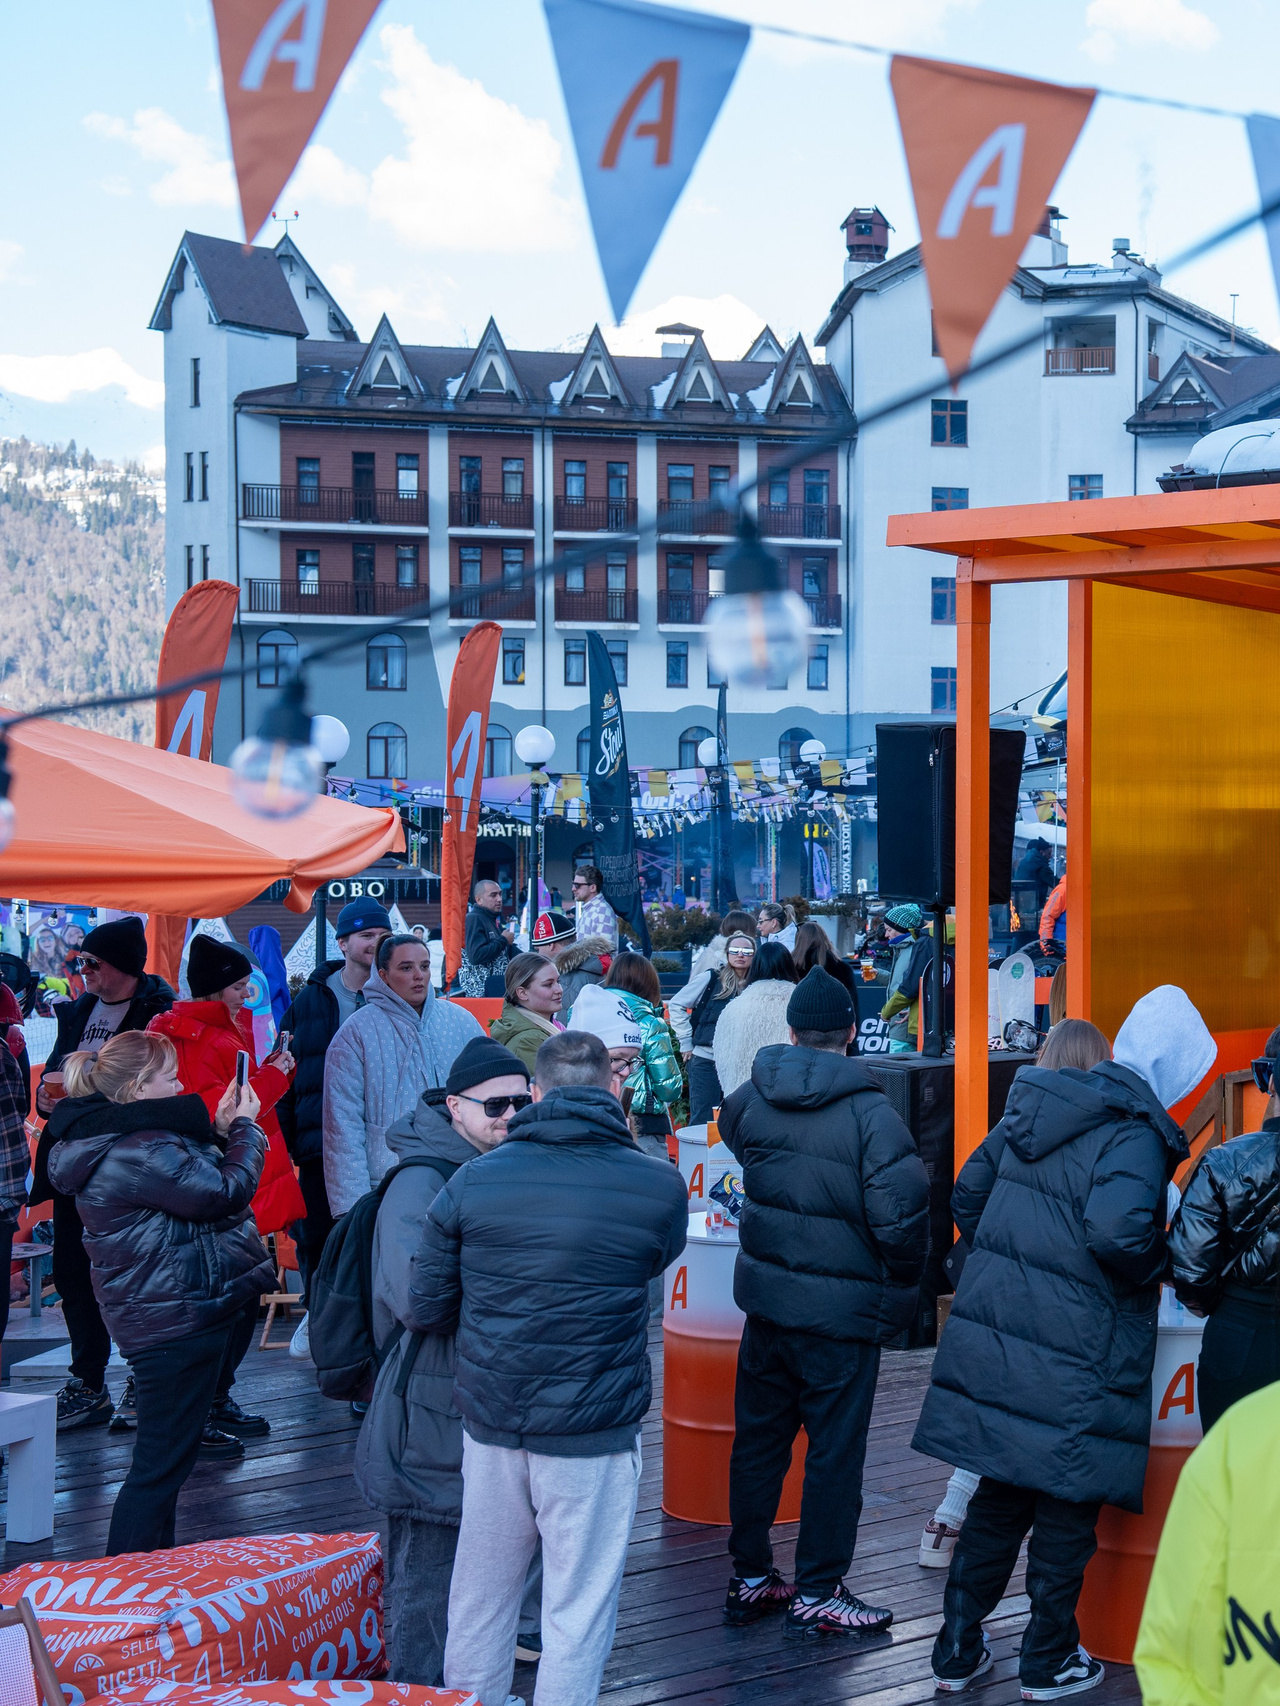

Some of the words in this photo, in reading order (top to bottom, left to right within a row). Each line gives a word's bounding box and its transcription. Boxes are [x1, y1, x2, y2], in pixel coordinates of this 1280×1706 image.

[599, 56, 681, 171] A
[936, 122, 1027, 240] A
[452, 711, 482, 832] A
[688, 1163, 704, 1200] A
[670, 1266, 687, 1310] A
[1157, 1362, 1194, 1420] A
[291, 1596, 355, 1653] CONTAGIOUS
[299, 1584, 331, 1618] The
